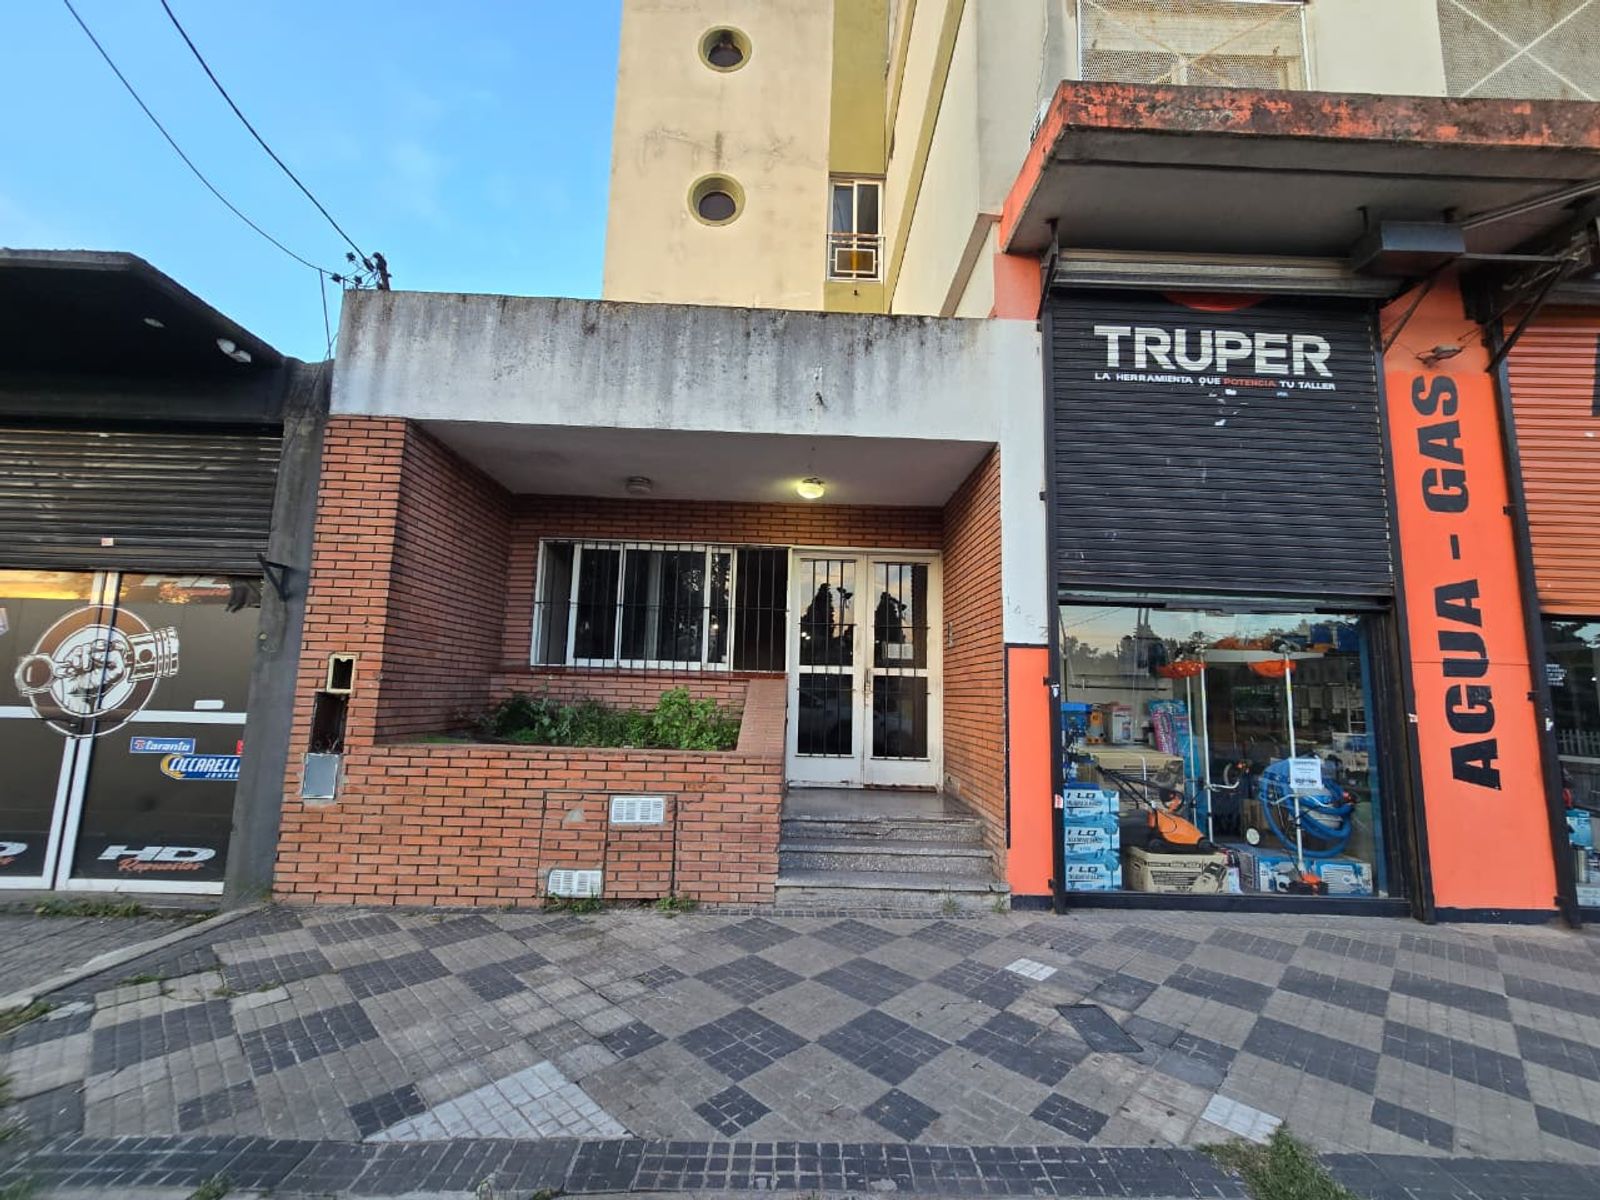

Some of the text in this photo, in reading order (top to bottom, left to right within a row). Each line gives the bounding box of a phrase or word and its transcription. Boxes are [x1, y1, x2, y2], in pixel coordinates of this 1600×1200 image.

[1093, 325, 1333, 377] TRUPER
[1094, 372, 1337, 391] LA HERRAMIENTA QUE POTENCIA TU TALLER
[1412, 375, 1471, 513] GAS
[1434, 579, 1502, 790] AGUA
[168, 758, 240, 772] CICCARELL
